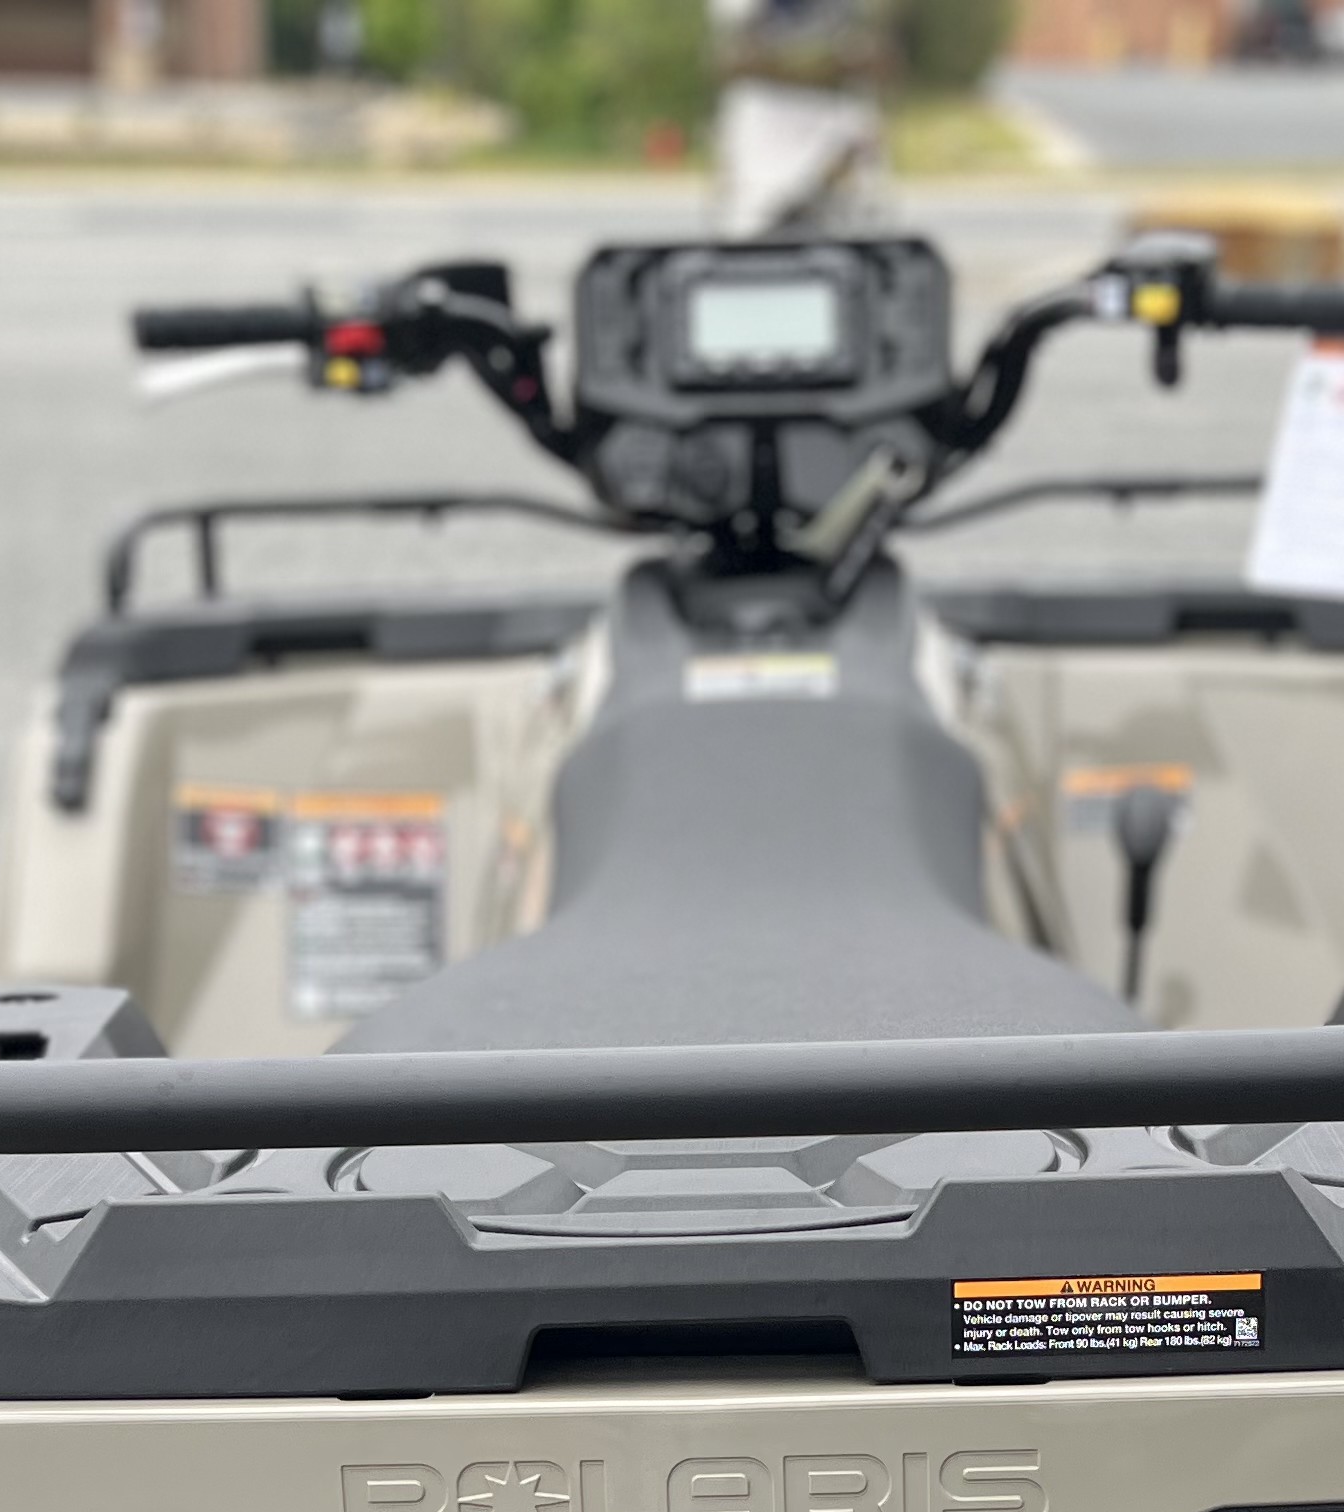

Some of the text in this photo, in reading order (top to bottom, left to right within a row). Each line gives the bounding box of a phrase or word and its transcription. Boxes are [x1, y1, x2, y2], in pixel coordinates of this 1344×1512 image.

[1076, 1279, 1156, 1292] WARNING
[963, 1294, 1212, 1311] DO NOT TOW FROM RACK OR BUMPER.
[963, 1308, 1245, 1325] Vehicle damage or tipover may result causing severe
[963, 1321, 1227, 1340] injury or death. Tow only from tow hooks or hitch.
[963, 1341, 987, 1352] Max.
[987, 1340, 1013, 1351] Rack
[1014, 1340, 1047, 1350] Loads:
[1048, 1338, 1075, 1349] Front
[1076, 1338, 1089, 1349] 90
[1122, 1337, 1138, 1349] kg)
[1140, 1336, 1163, 1347] Rear
[1164, 1335, 1183, 1346] 180
[1217, 1334, 1233, 1347] kg)
